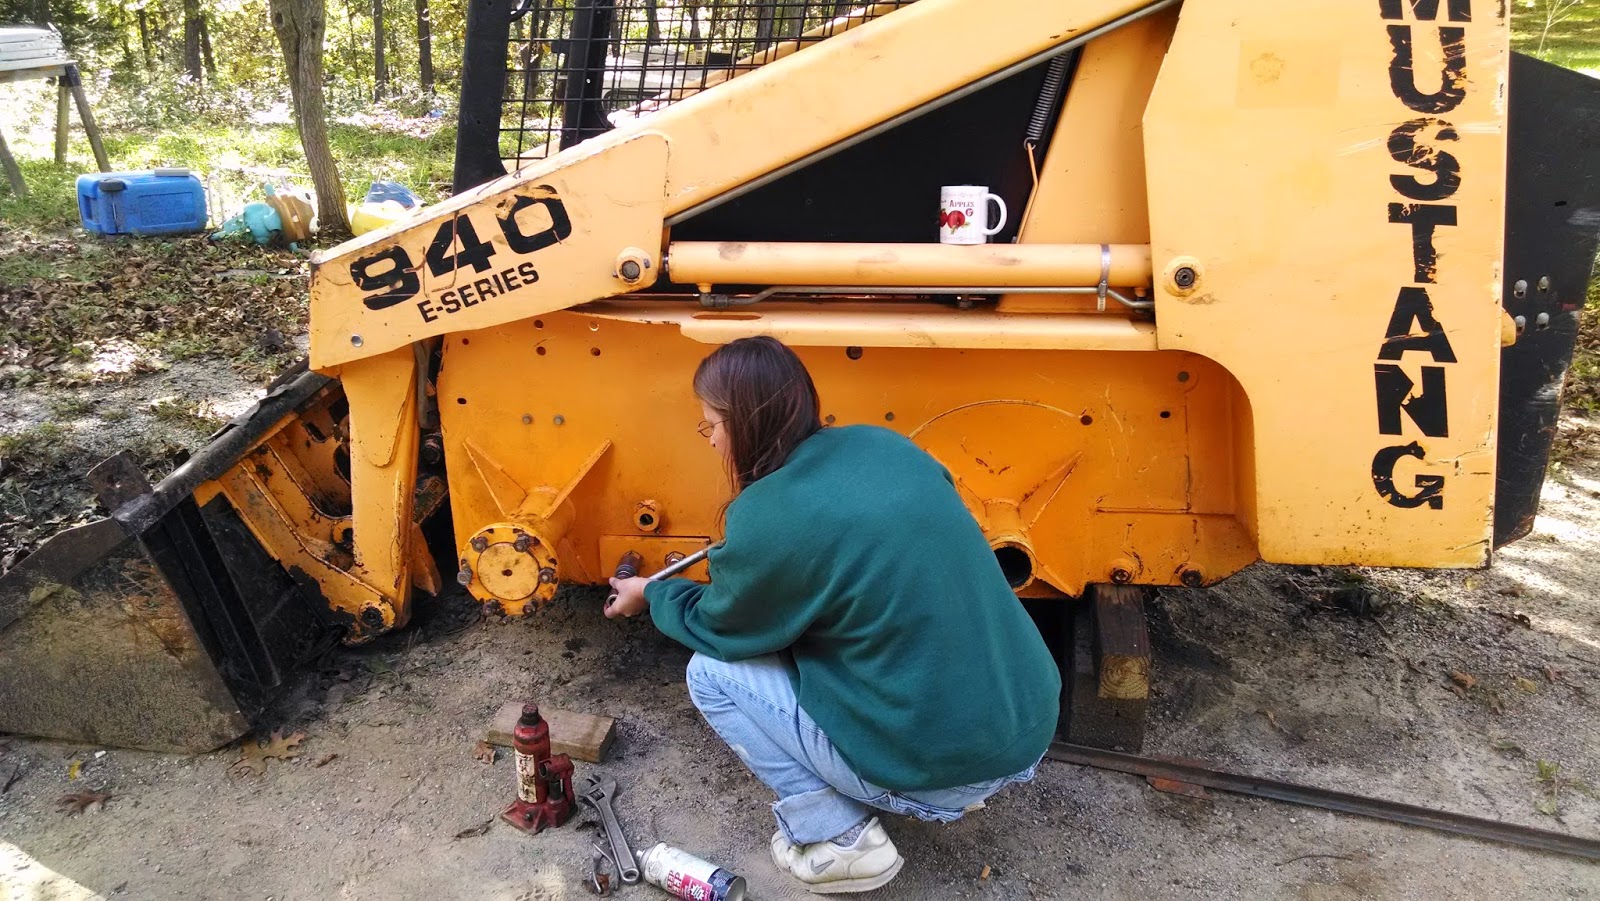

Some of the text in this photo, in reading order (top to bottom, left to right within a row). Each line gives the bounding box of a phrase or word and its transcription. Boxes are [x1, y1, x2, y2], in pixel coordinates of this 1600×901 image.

[350, 184, 572, 311] 940
[416, 261, 540, 324] E-SERIES
[1371, 0, 1471, 510] USTANG
